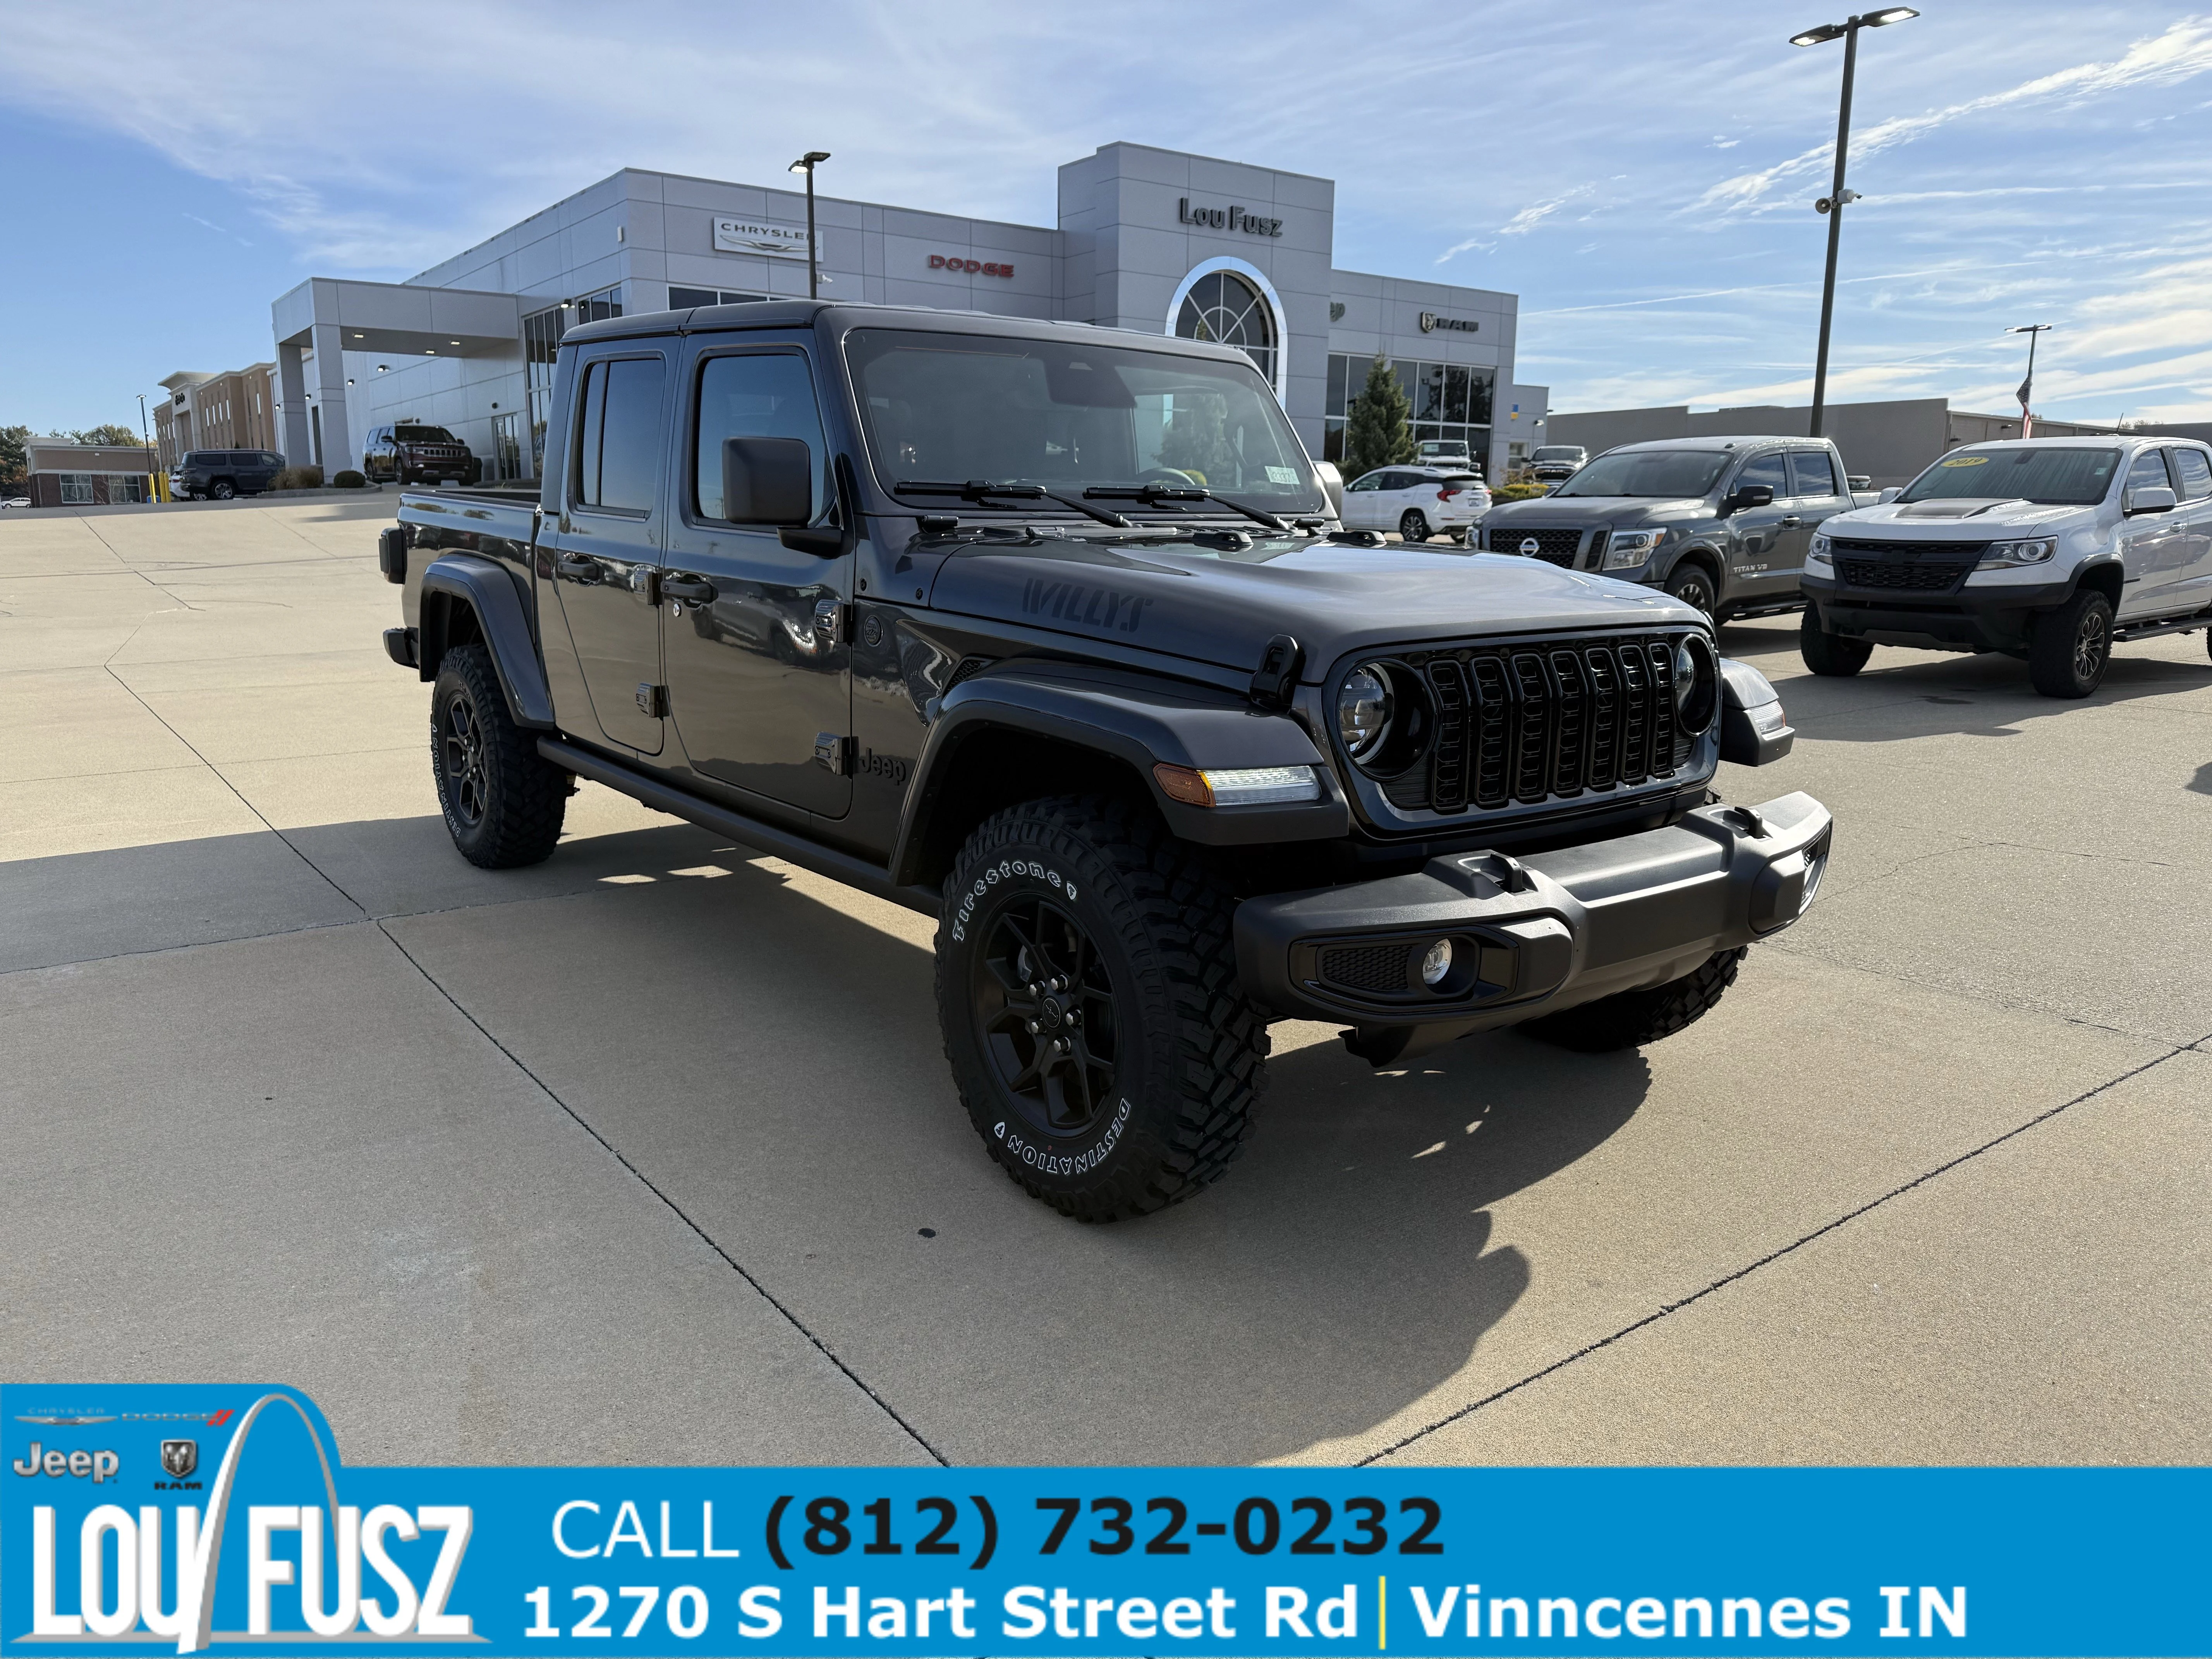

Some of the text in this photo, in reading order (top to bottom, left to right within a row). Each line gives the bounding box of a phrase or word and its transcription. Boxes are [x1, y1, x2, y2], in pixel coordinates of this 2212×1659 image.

[721, 222, 809, 240] CHRYSLE
[1180, 198, 1283, 237] Lou Fusz
[929, 254, 1014, 278] DODGE
[1437, 318, 1479, 332] RAM
[1948, 458, 1983, 466] 2019
[1733, 565, 1755, 573] TITAN
[1022, 578, 1154, 632] WILLYS
[860, 747, 907, 786] Jeep
[952, 859, 1062, 943] Firestone
[1007, 1097, 1132, 1175] DESTINATION
